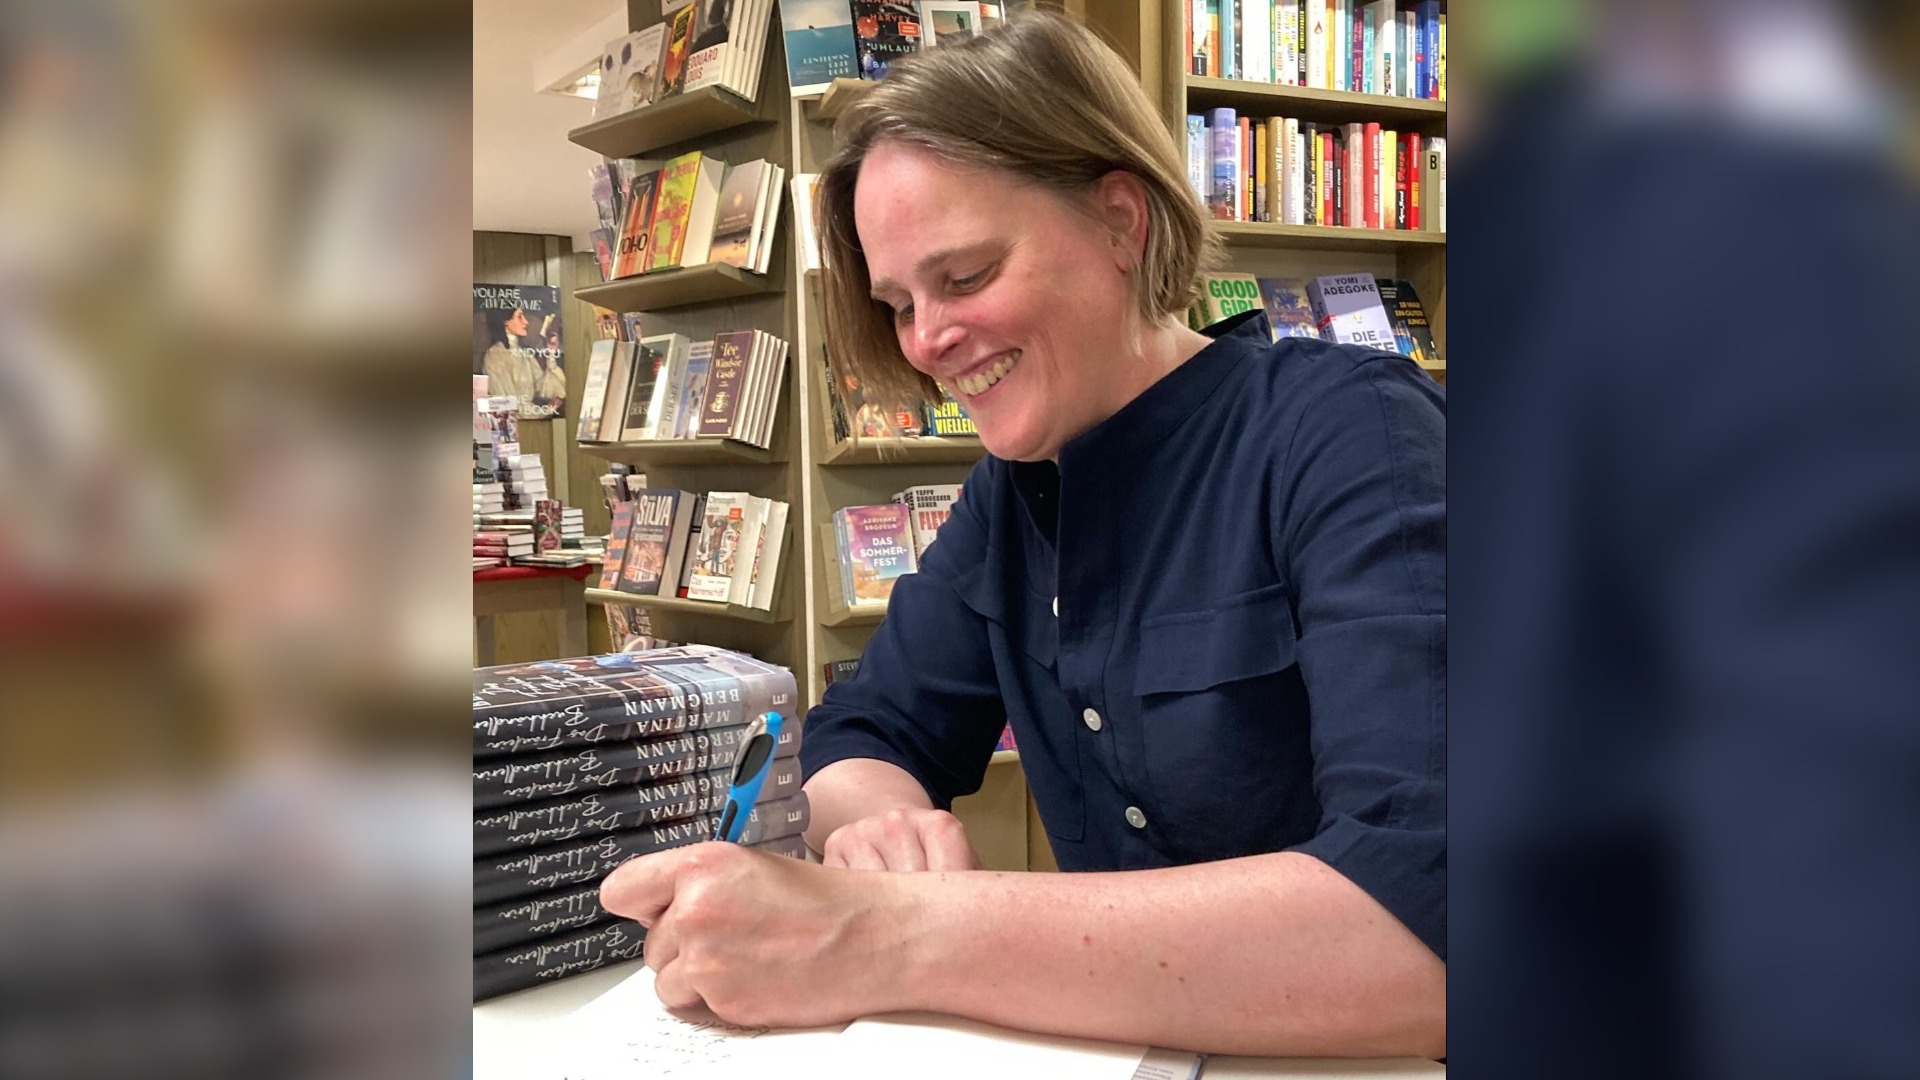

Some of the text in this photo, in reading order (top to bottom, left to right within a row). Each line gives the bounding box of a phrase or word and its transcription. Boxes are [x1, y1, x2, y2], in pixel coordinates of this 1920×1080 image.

[870, 43, 917, 53] UMLAUF
[1430, 155, 1437, 169] B
[1334, 277, 1358, 285] YOMI
[473, 287, 520, 299] YOU ARE
[1208, 279, 1258, 298] GOOD
[1323, 284, 1376, 296] ADEGOKE
[480, 298, 542, 311] AWESOME
[1352, 330, 1378, 343] DIE
[536, 347, 560, 358] YOU
[720, 342, 739, 356] Tee
[524, 404, 560, 416] BOOK
[636, 495, 673, 527] SILVA
[872, 537, 893, 546] DAS
[860, 546, 908, 558] SOMMER-
[873, 557, 897, 567] FEST
[624, 688, 740, 717] BERGMANN
[473, 704, 590, 737] Buchhändler
[637, 709, 731, 734] MARTINA
[567, 723, 609, 743] Das
[636, 729, 746, 760] BERGMANN
[648, 751, 735, 776] MARTINA
[581, 767, 621, 787] Das
[650, 793, 729, 820] ARTINA
[583, 811, 624, 831] Das
[498, 888, 600, 921] uchhändlerin
